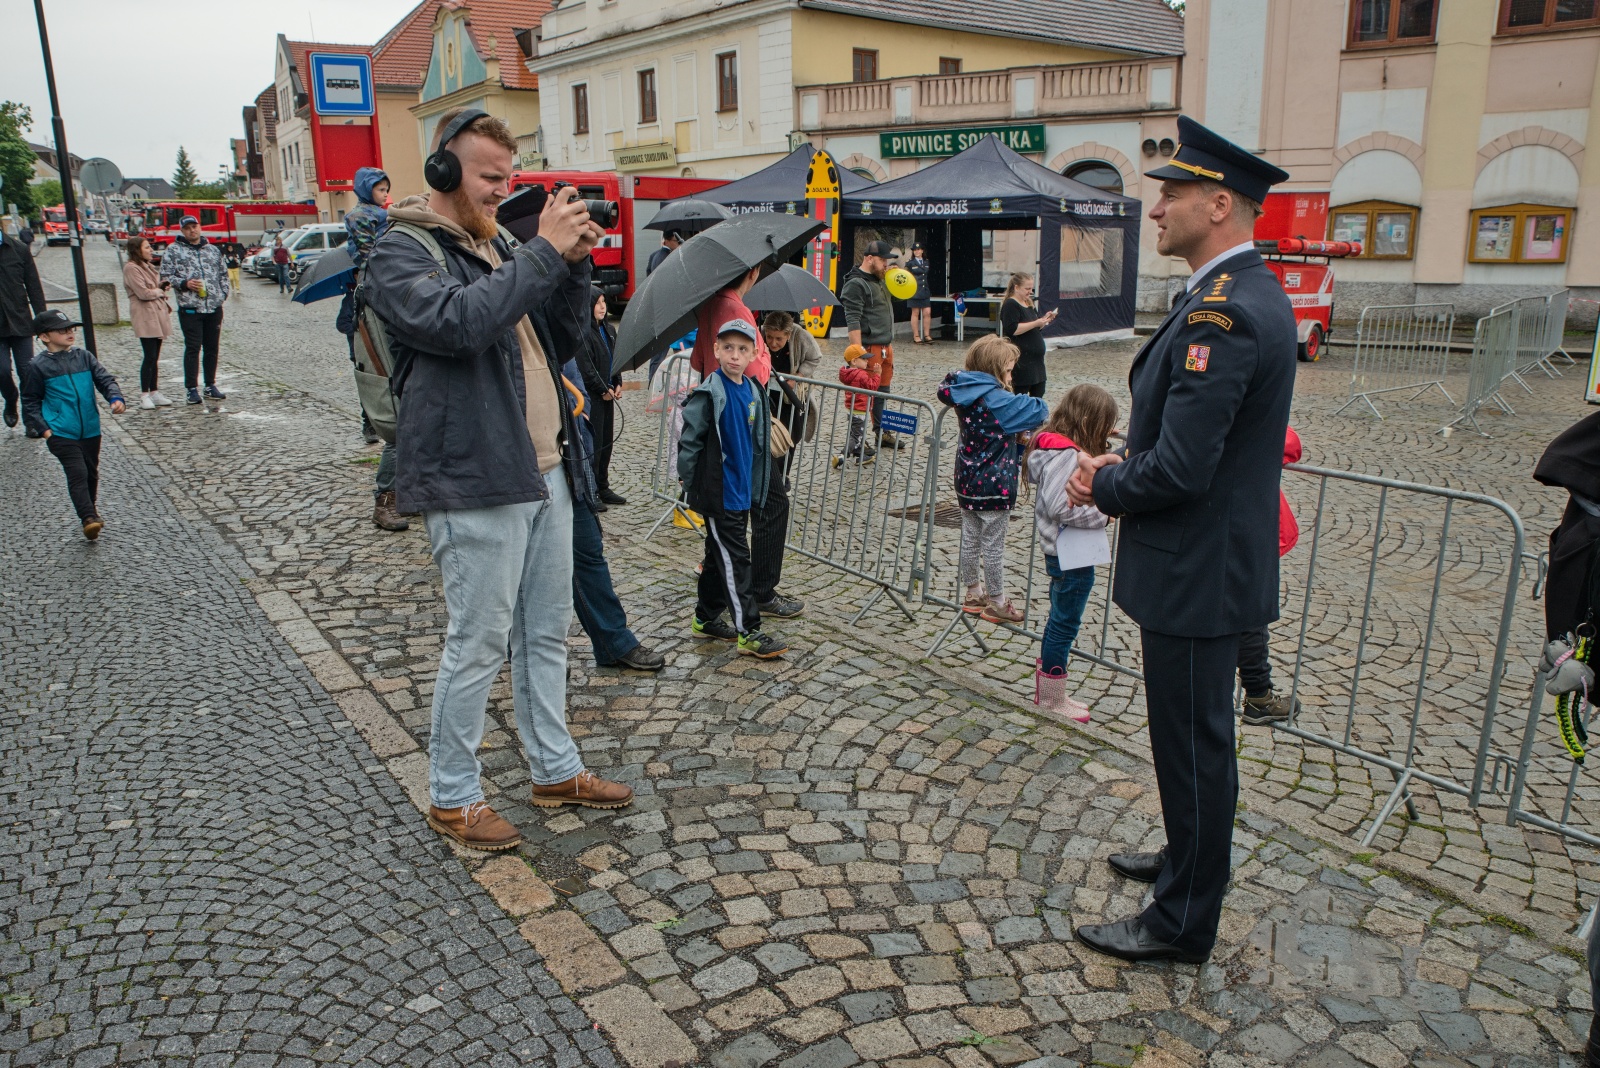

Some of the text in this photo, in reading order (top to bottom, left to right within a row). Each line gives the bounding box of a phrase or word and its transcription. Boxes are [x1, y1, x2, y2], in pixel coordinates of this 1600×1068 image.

[892, 130, 1032, 154] PIVNICE SOLKA
[619, 154, 645, 165] RESTAURACE
[888, 199, 969, 215] HASIČI DOBŘÍŠ
[1074, 200, 1093, 215] HASIČI
[1291, 295, 1304, 306] ASIČI
